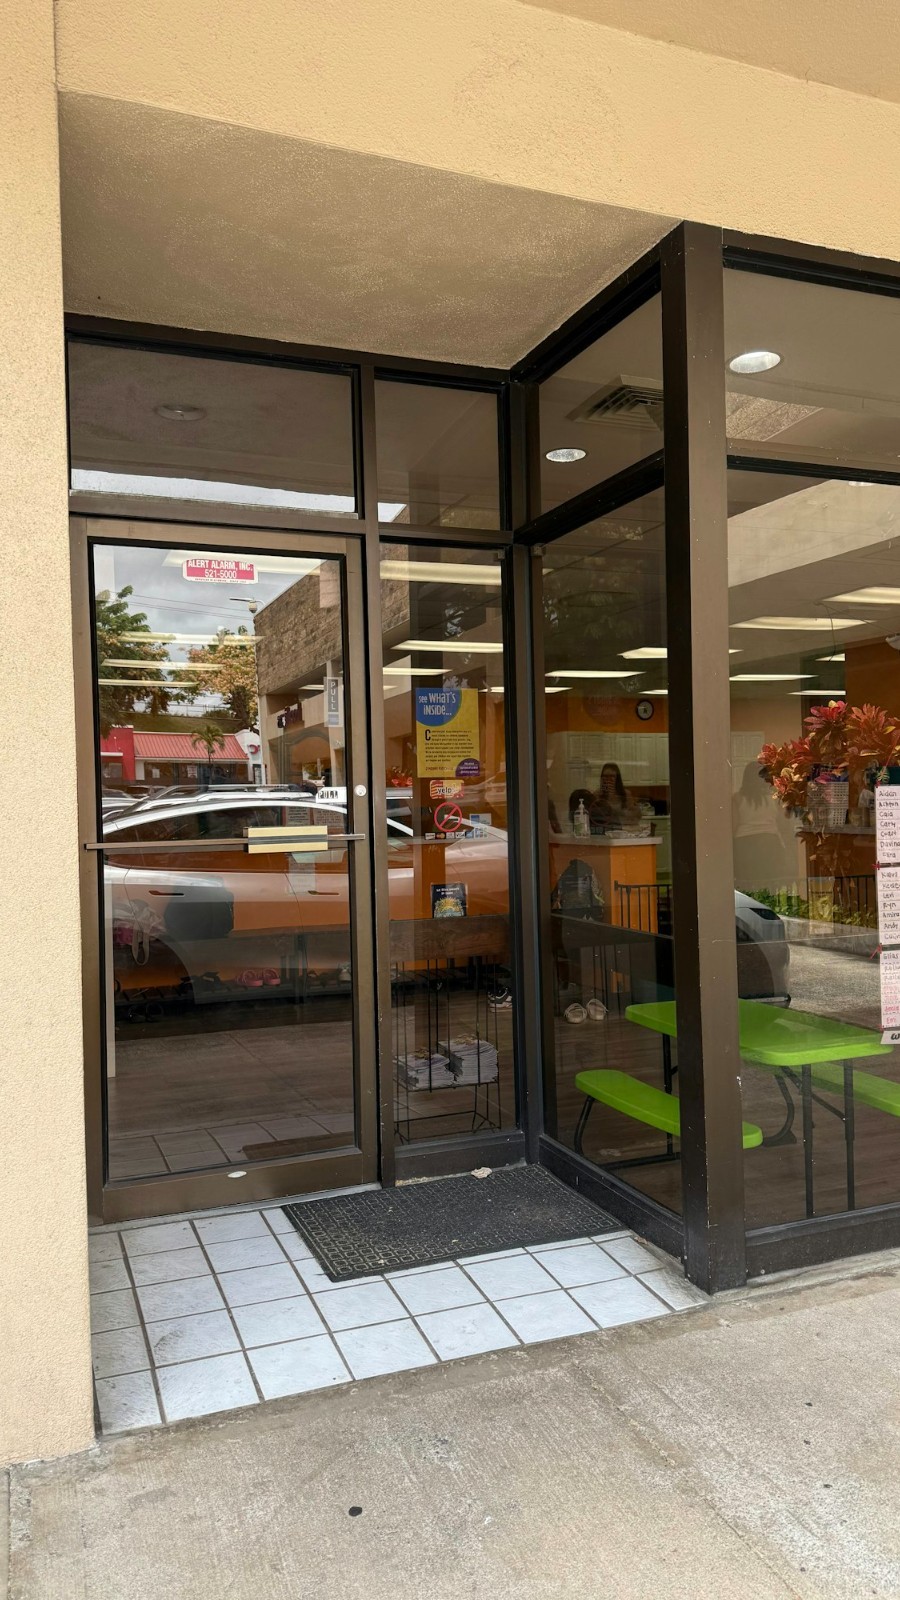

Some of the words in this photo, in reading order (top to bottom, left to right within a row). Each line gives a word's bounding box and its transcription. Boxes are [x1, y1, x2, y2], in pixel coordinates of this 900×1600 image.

[188, 560, 209, 568] ALERT
[211, 561, 238, 571] ALARM,
[205, 569, 237, 578] 521-5000
[418, 695, 428, 703] see
[437, 786, 452, 795] yelp
